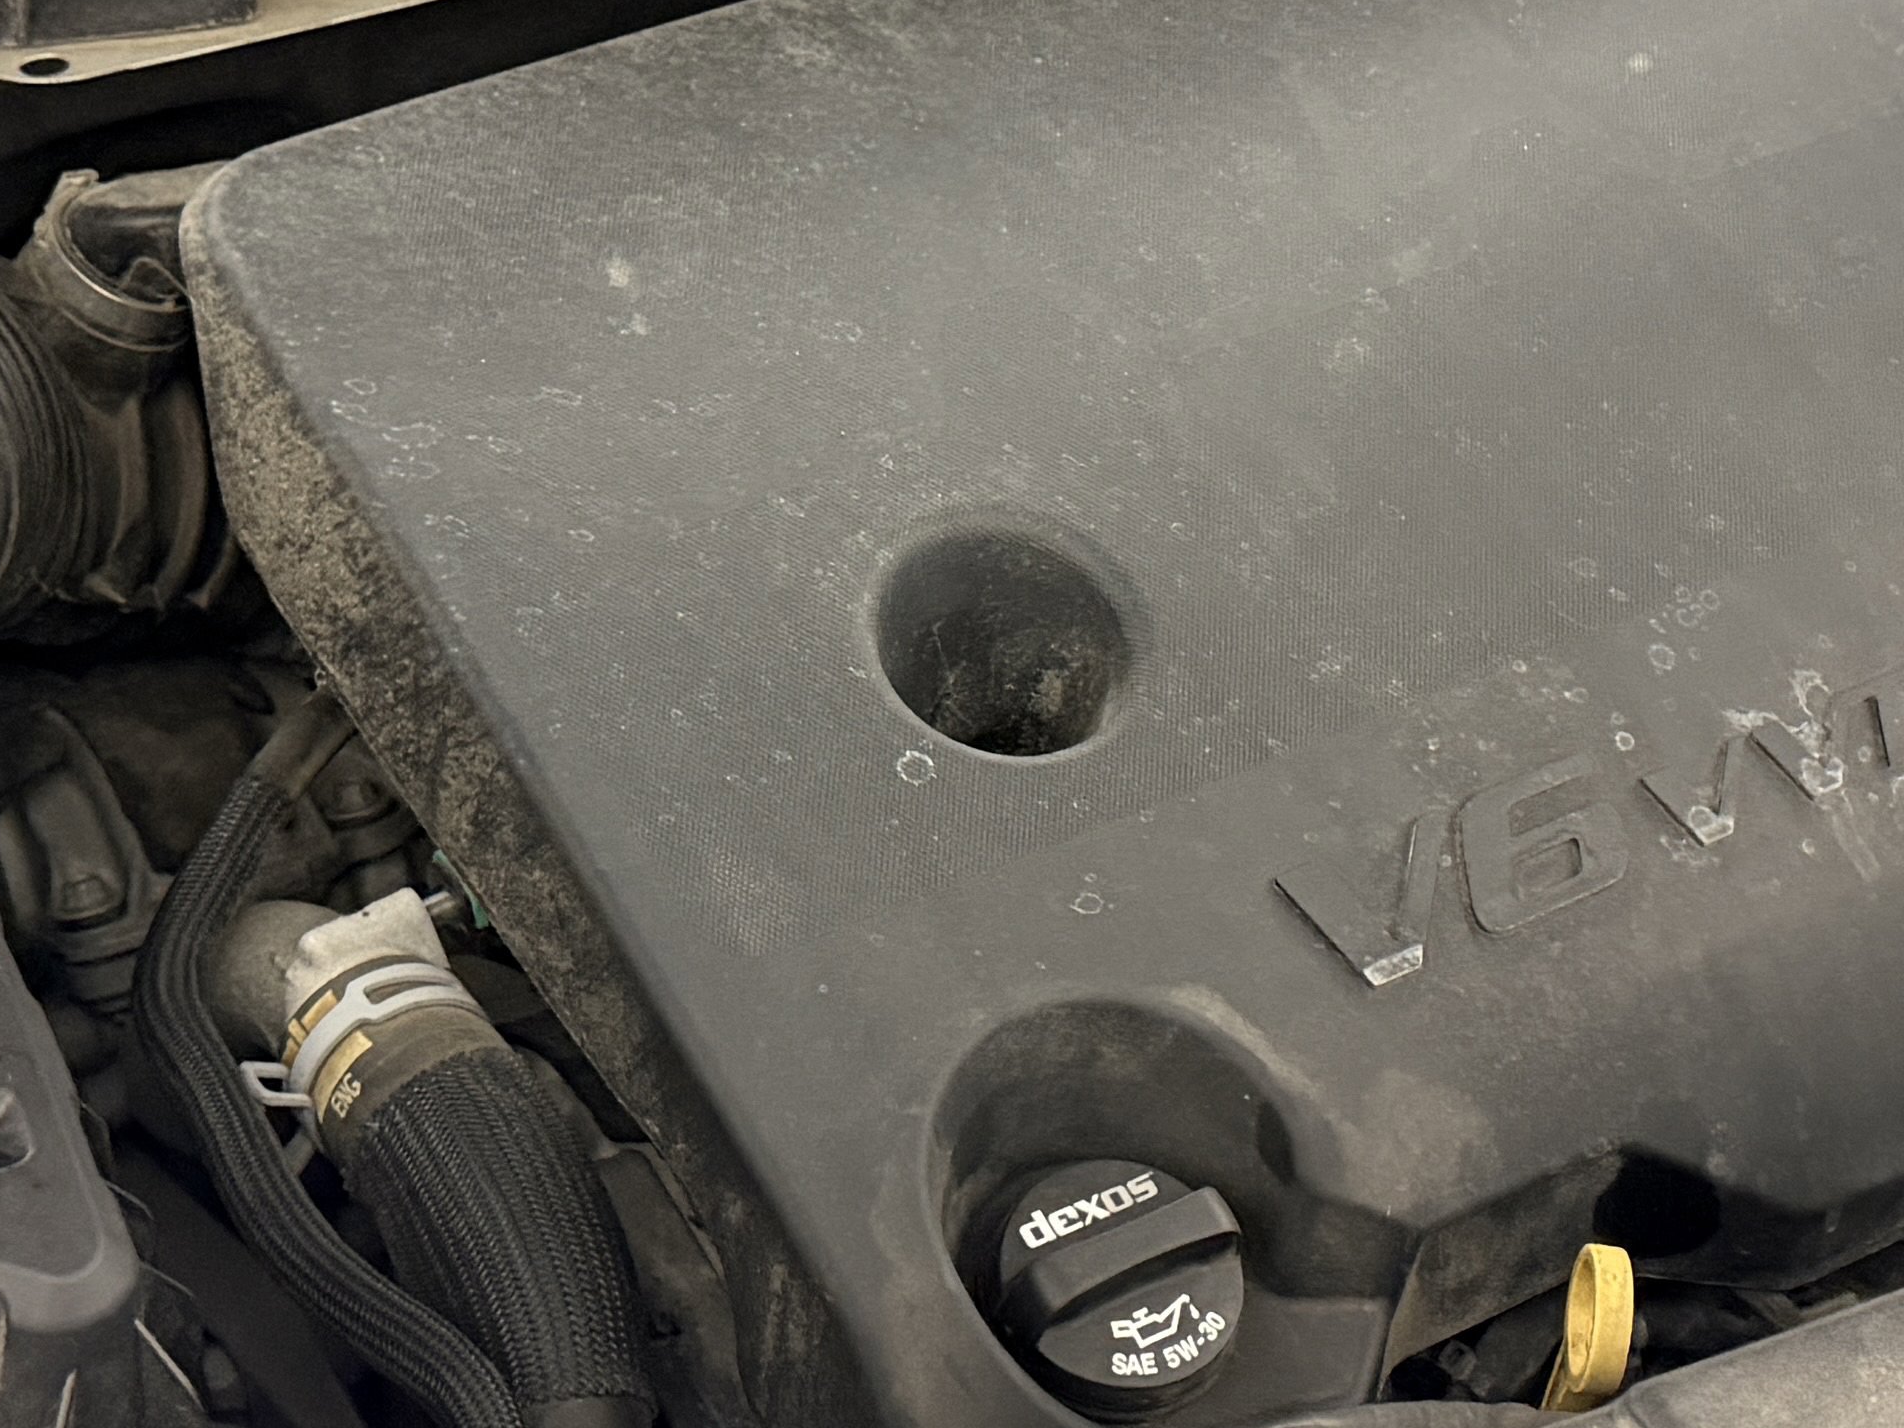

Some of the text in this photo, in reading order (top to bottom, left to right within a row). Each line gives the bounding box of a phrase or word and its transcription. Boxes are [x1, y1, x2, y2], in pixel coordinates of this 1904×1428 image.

[1273, 755, 1630, 990] V6
[330, 1071, 362, 1119] ENG
[1018, 1172, 1159, 1249] dexos
[1110, 1310, 1227, 1376] SAE 5W-30
